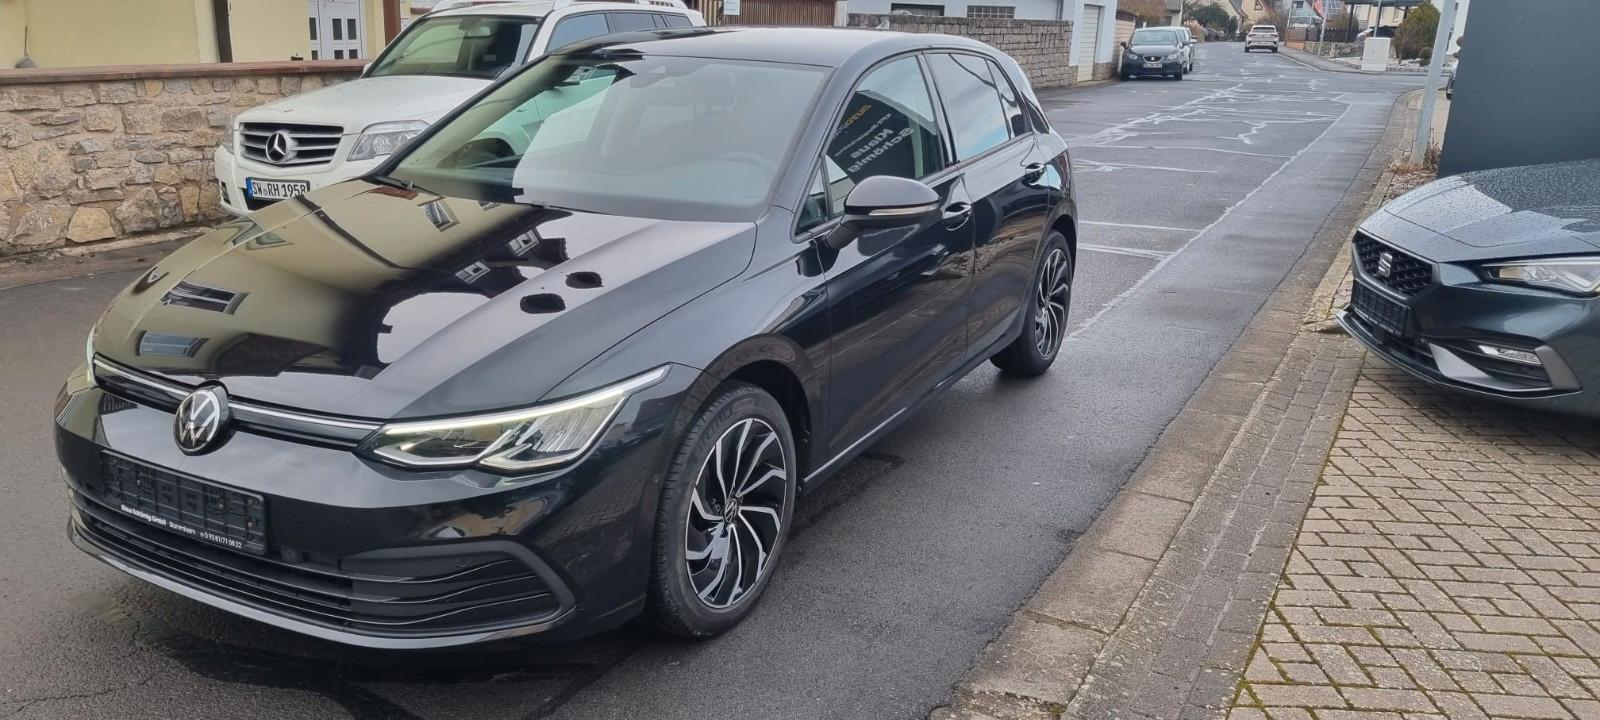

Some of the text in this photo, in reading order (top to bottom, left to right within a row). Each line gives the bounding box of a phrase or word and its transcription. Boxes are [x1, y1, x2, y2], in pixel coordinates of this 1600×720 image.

[252, 181, 306, 198] SW RH 1958
